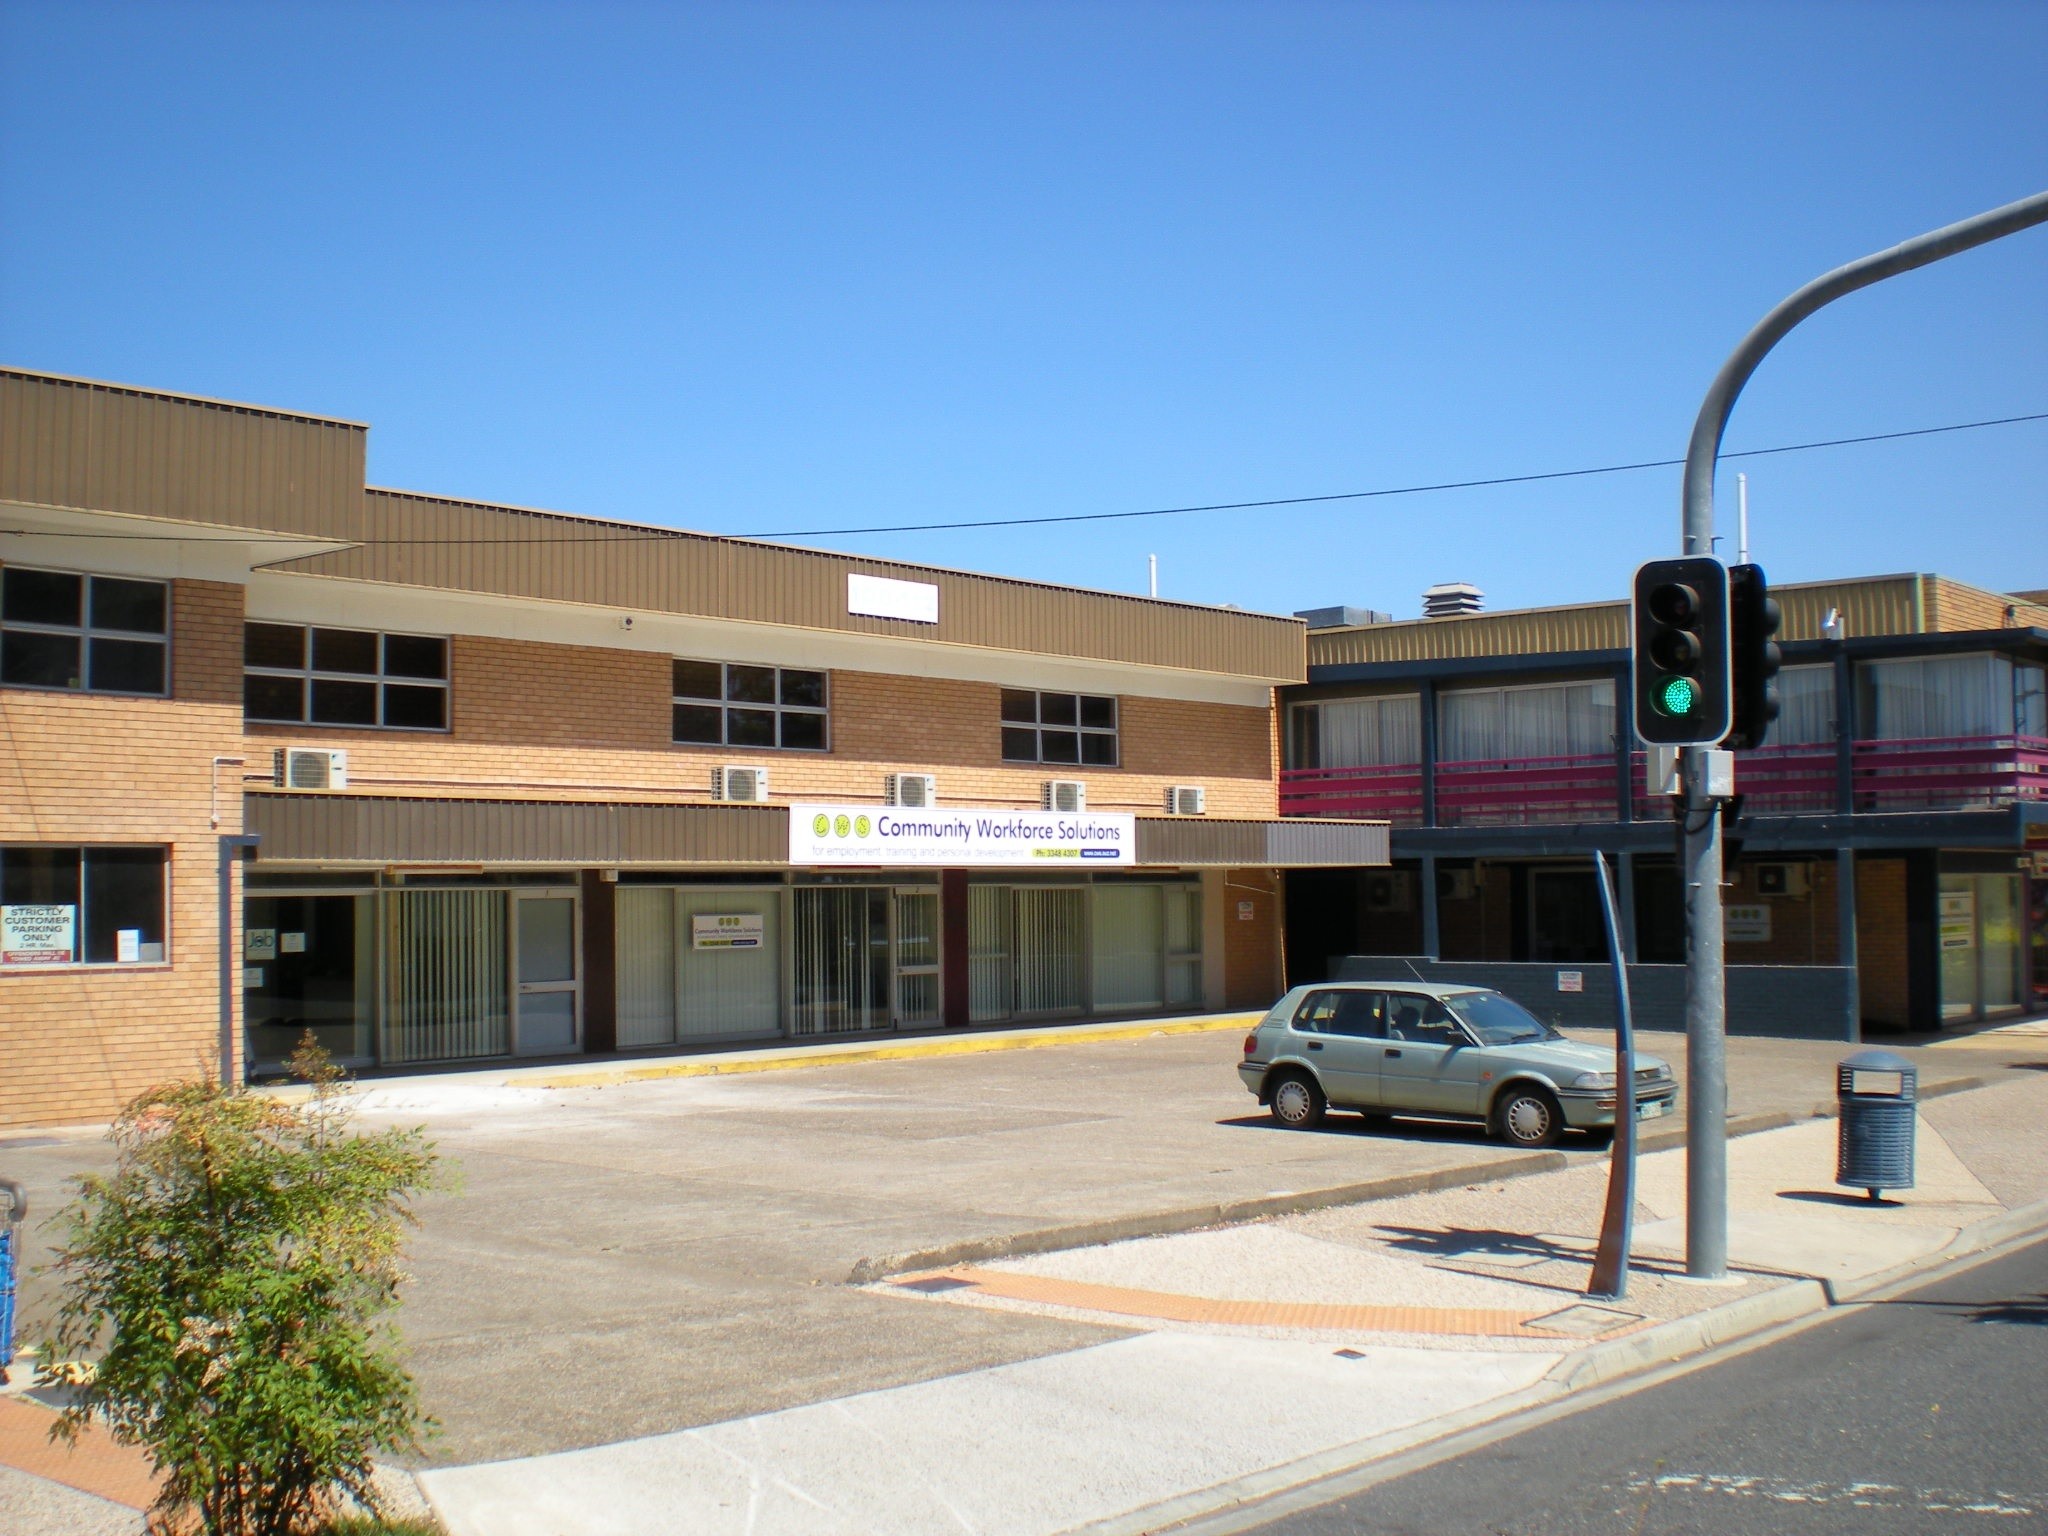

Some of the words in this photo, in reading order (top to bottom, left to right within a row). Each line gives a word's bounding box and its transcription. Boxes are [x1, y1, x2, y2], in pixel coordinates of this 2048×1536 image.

[878, 816, 971, 843] Community
[976, 818, 1054, 840] Workforce
[1058, 820, 1121, 840] Solutions
[812, 845, 824, 856] for
[886, 846, 918, 859] training
[919, 847, 935, 857] and
[937, 847, 971, 858] personal
[975, 848, 1024, 859] development
[11, 908, 64, 916] STRICTLY
[4, 917, 70, 925] CUSTOMER
[11, 925, 63, 933] PARKING
